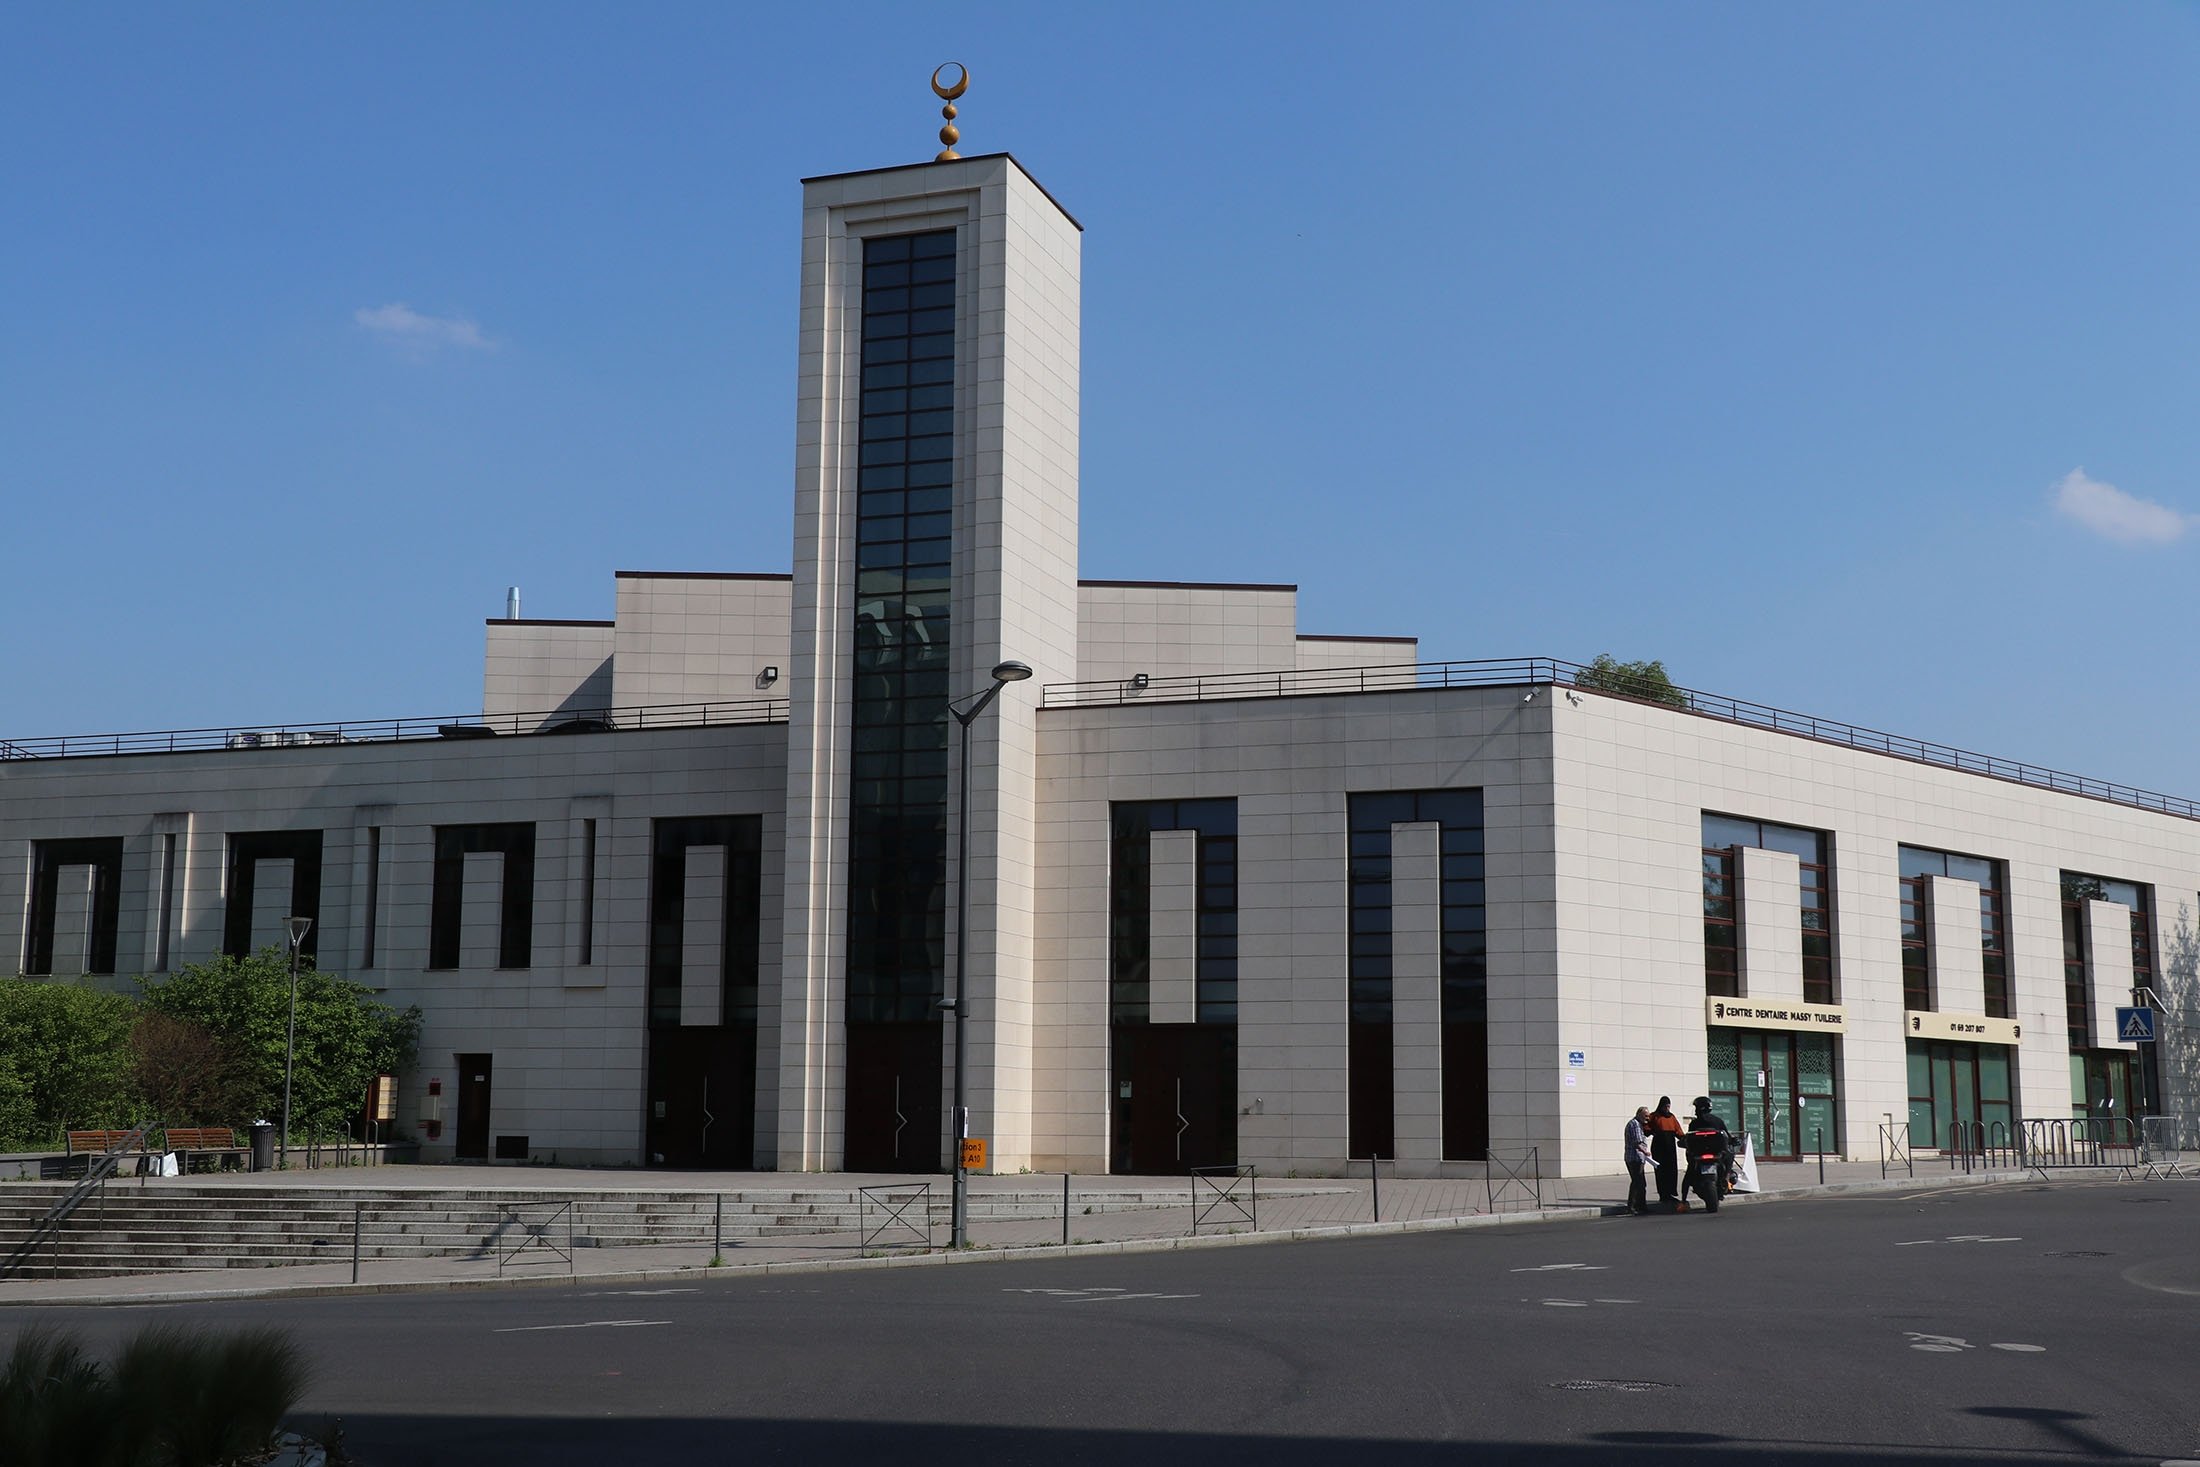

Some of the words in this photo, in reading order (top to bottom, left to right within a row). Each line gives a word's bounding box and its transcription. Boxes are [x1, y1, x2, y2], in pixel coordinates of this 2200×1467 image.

[1726, 1007, 1753, 1018] CENTRE
[1755, 1009, 1788, 1020] DENTAIRE
[1790, 1011, 1812, 1022] MASSY
[1814, 1014, 1842, 1024] TUILERIE
[1950, 1023, 1956, 1031] 01
